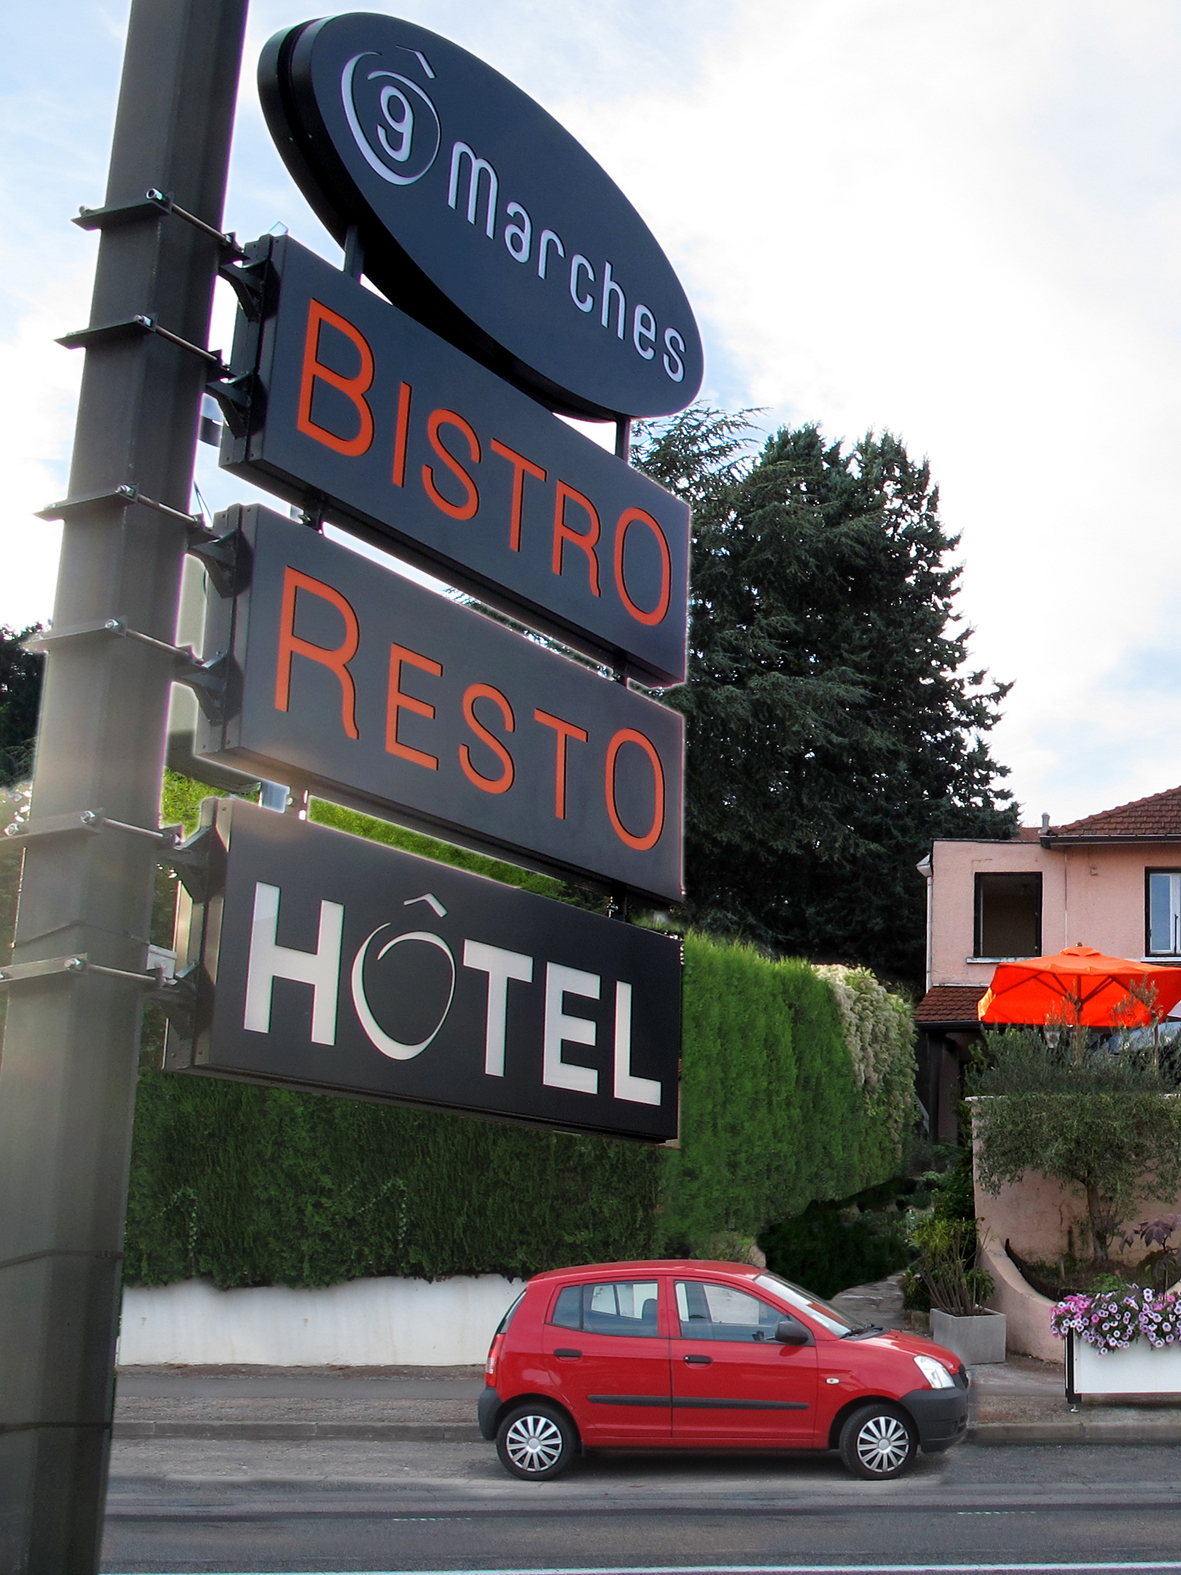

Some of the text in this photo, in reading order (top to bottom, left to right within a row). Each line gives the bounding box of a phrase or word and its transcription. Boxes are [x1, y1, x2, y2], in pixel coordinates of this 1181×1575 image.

[447, 141, 686, 384] marches
[297, 299, 671, 627] BISTRO
[275, 566, 665, 852] RESTO
[243, 881, 662, 1107] HÔTEL
